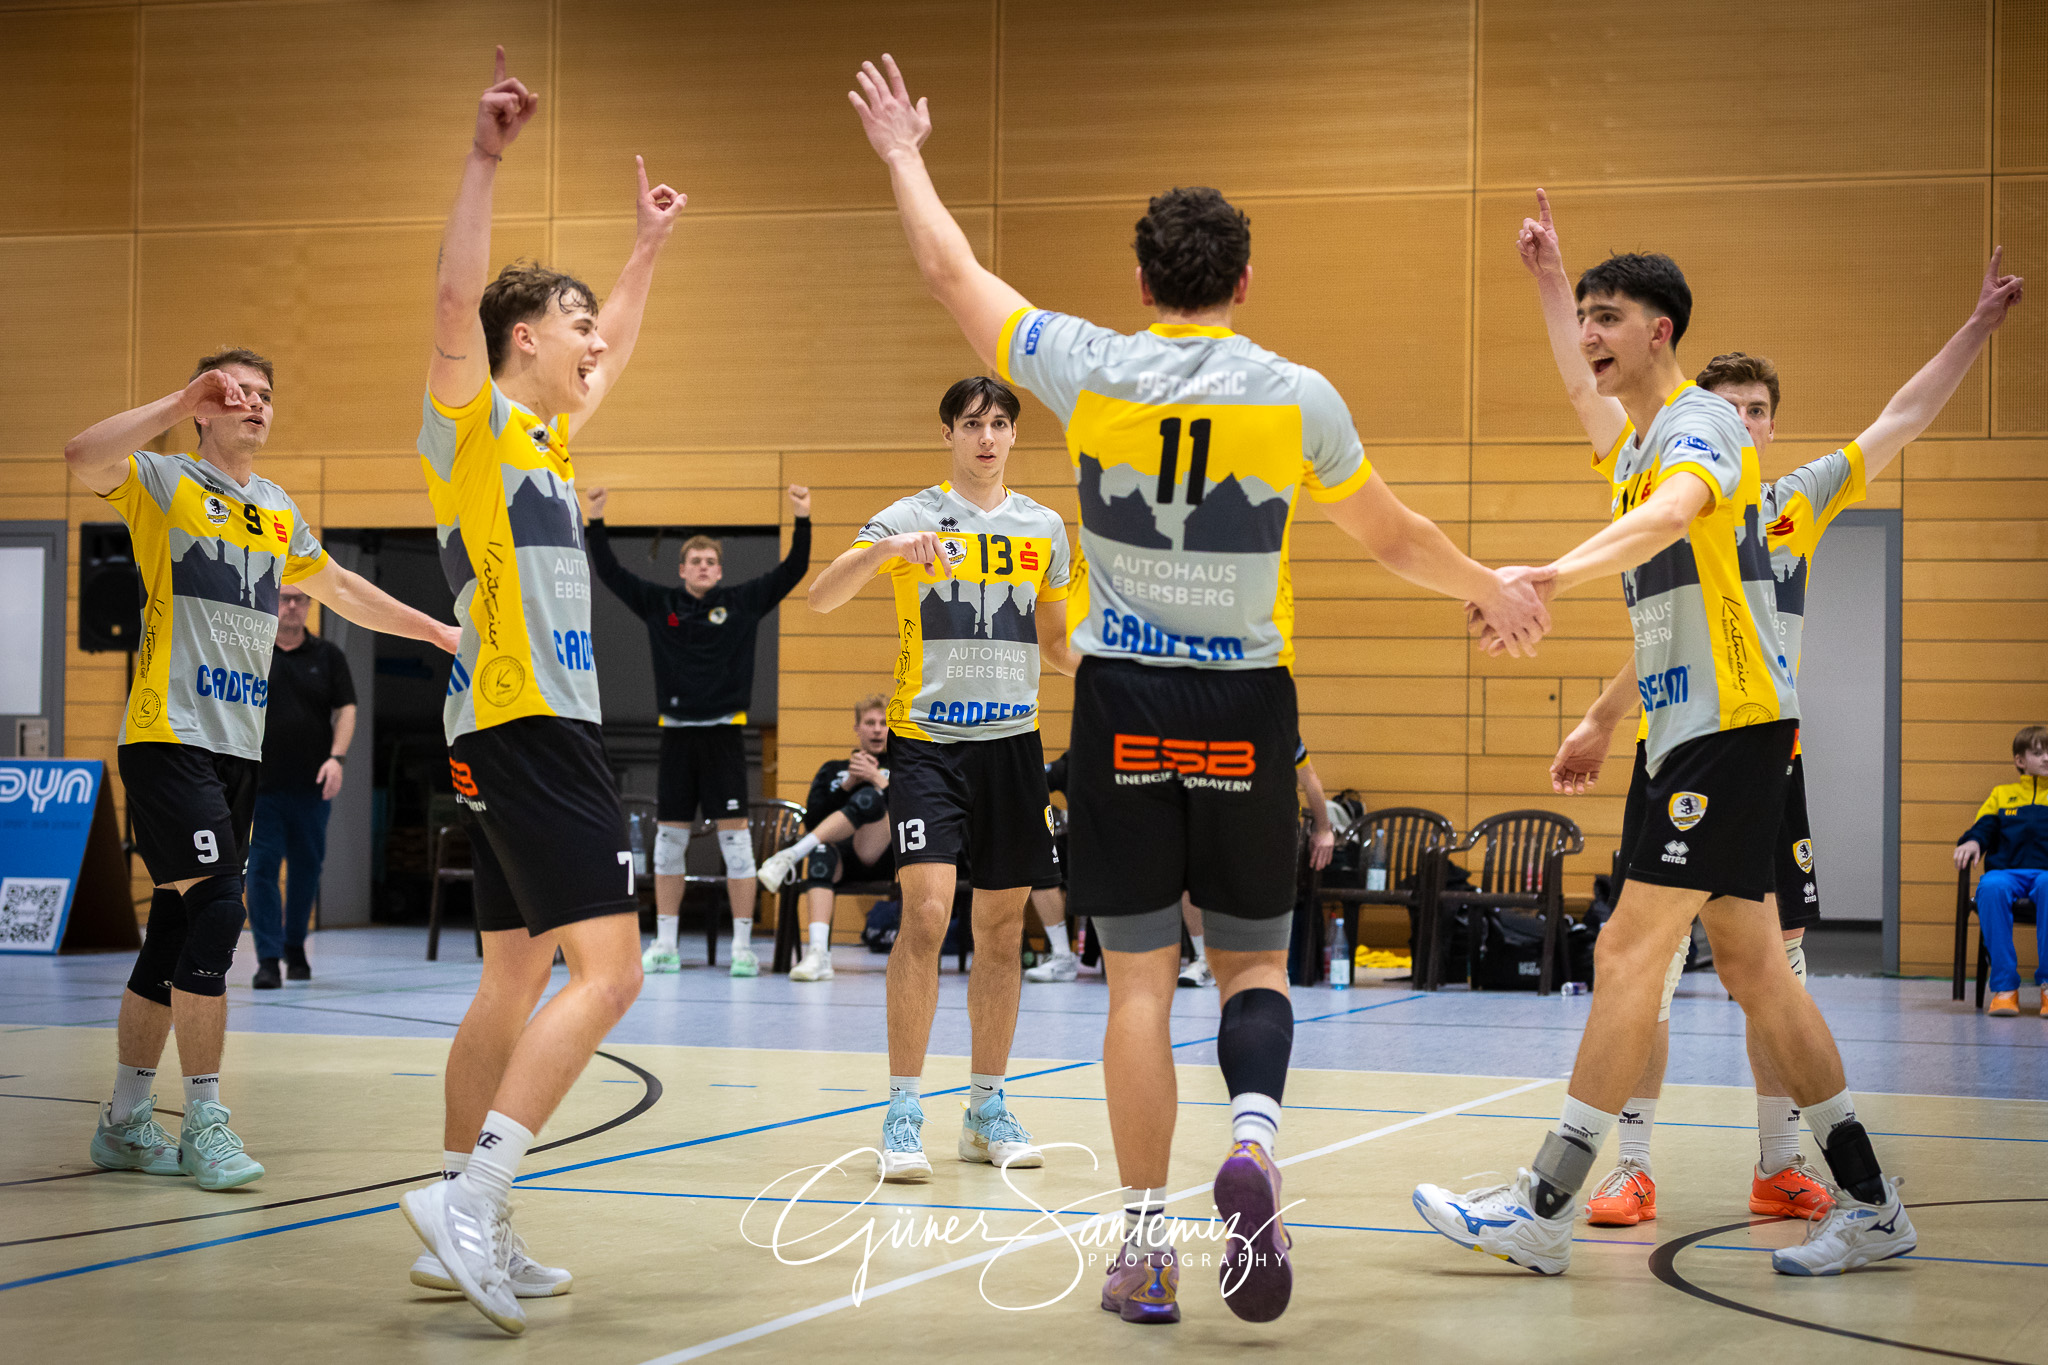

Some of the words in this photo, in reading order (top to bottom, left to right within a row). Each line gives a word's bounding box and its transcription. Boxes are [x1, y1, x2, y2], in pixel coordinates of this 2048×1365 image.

[1157, 417, 1211, 505] 11
[243, 503, 263, 535] 9
[978, 533, 1013, 575] 13
[1113, 553, 1237, 583] AUTOHAUS
[1112, 575, 1235, 607] EBERSBERG
[211, 610, 277, 638] AUTOHAU
[948, 647, 1027, 663] AUTOHAUS
[946, 665, 1025, 681] EBERSBERG
[1114, 733, 1257, 776] ESB
[193, 830, 219, 863] 9
[898, 818, 926, 853] 13
[617, 851, 635, 895] 7
